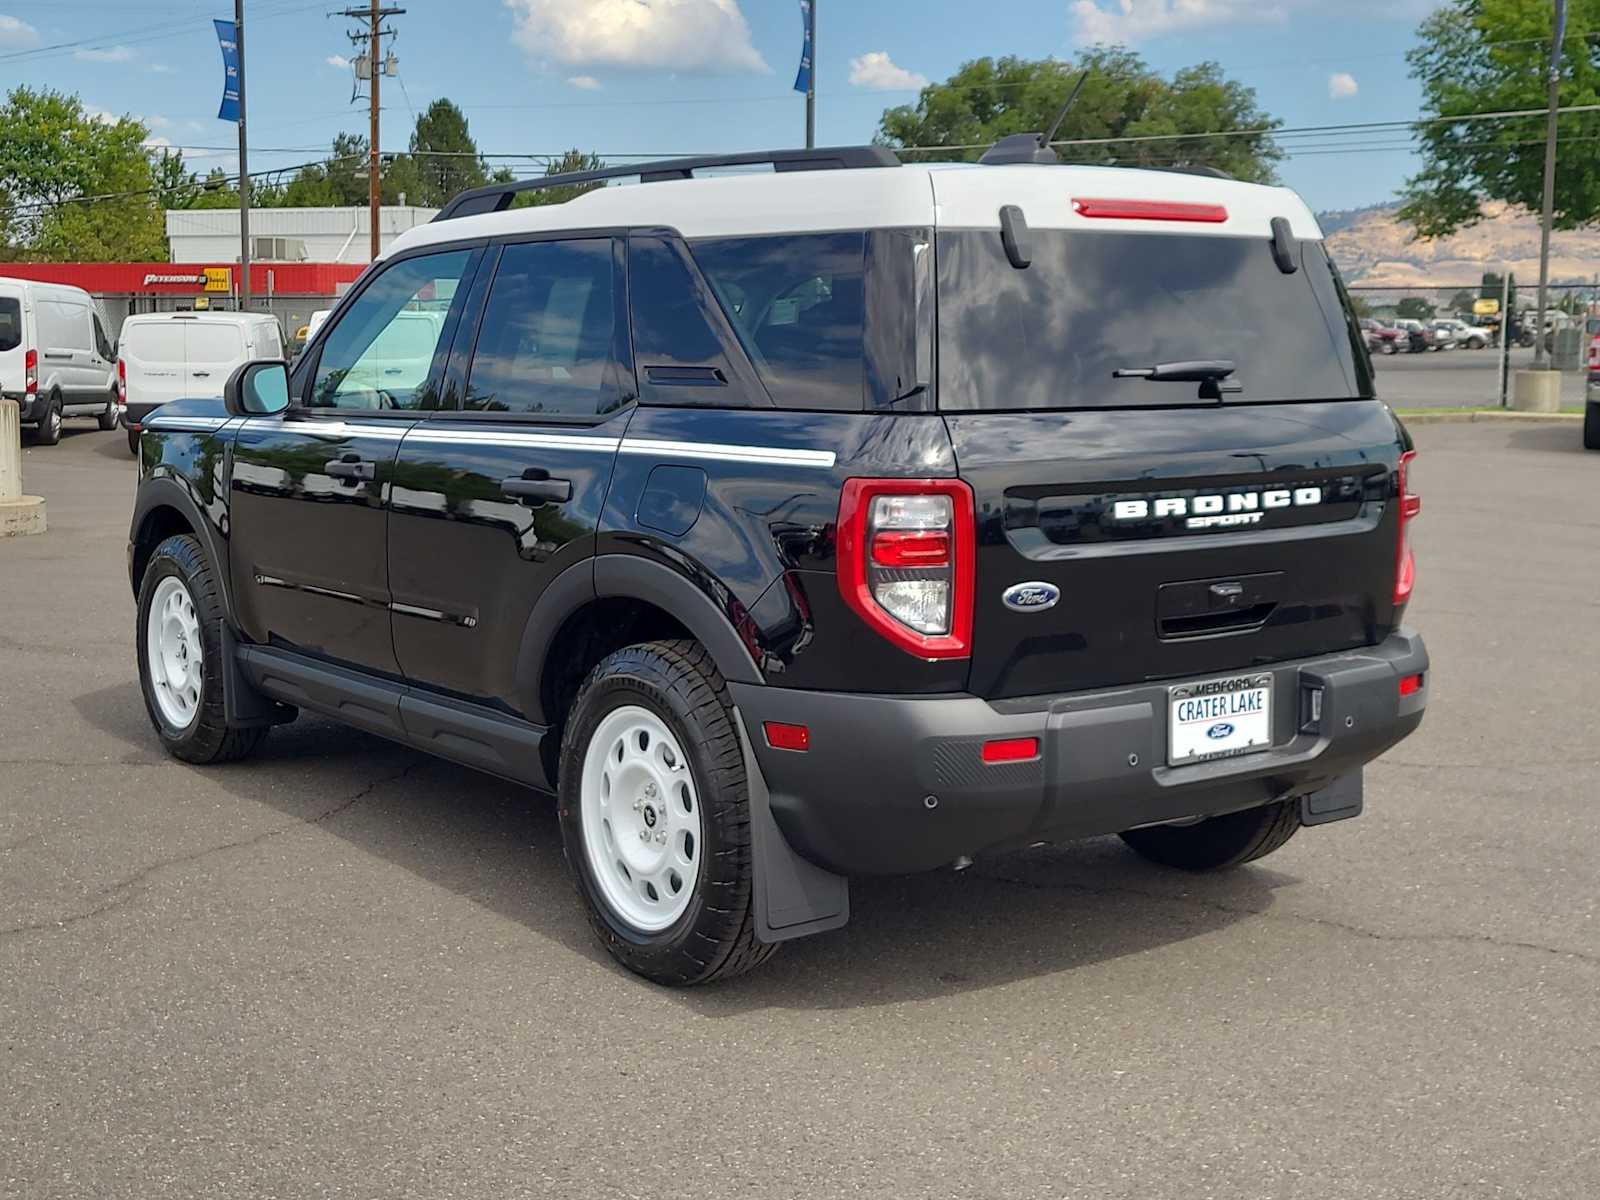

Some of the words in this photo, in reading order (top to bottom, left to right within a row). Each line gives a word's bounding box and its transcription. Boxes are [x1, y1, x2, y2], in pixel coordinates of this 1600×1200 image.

[1114, 487, 1322, 519] BRONCO
[1187, 511, 1264, 528] SPORT
[1196, 679, 1250, 695] MEDFORD
[1178, 696, 1227, 722] CRATER
[1231, 691, 1263, 713] LAKE
